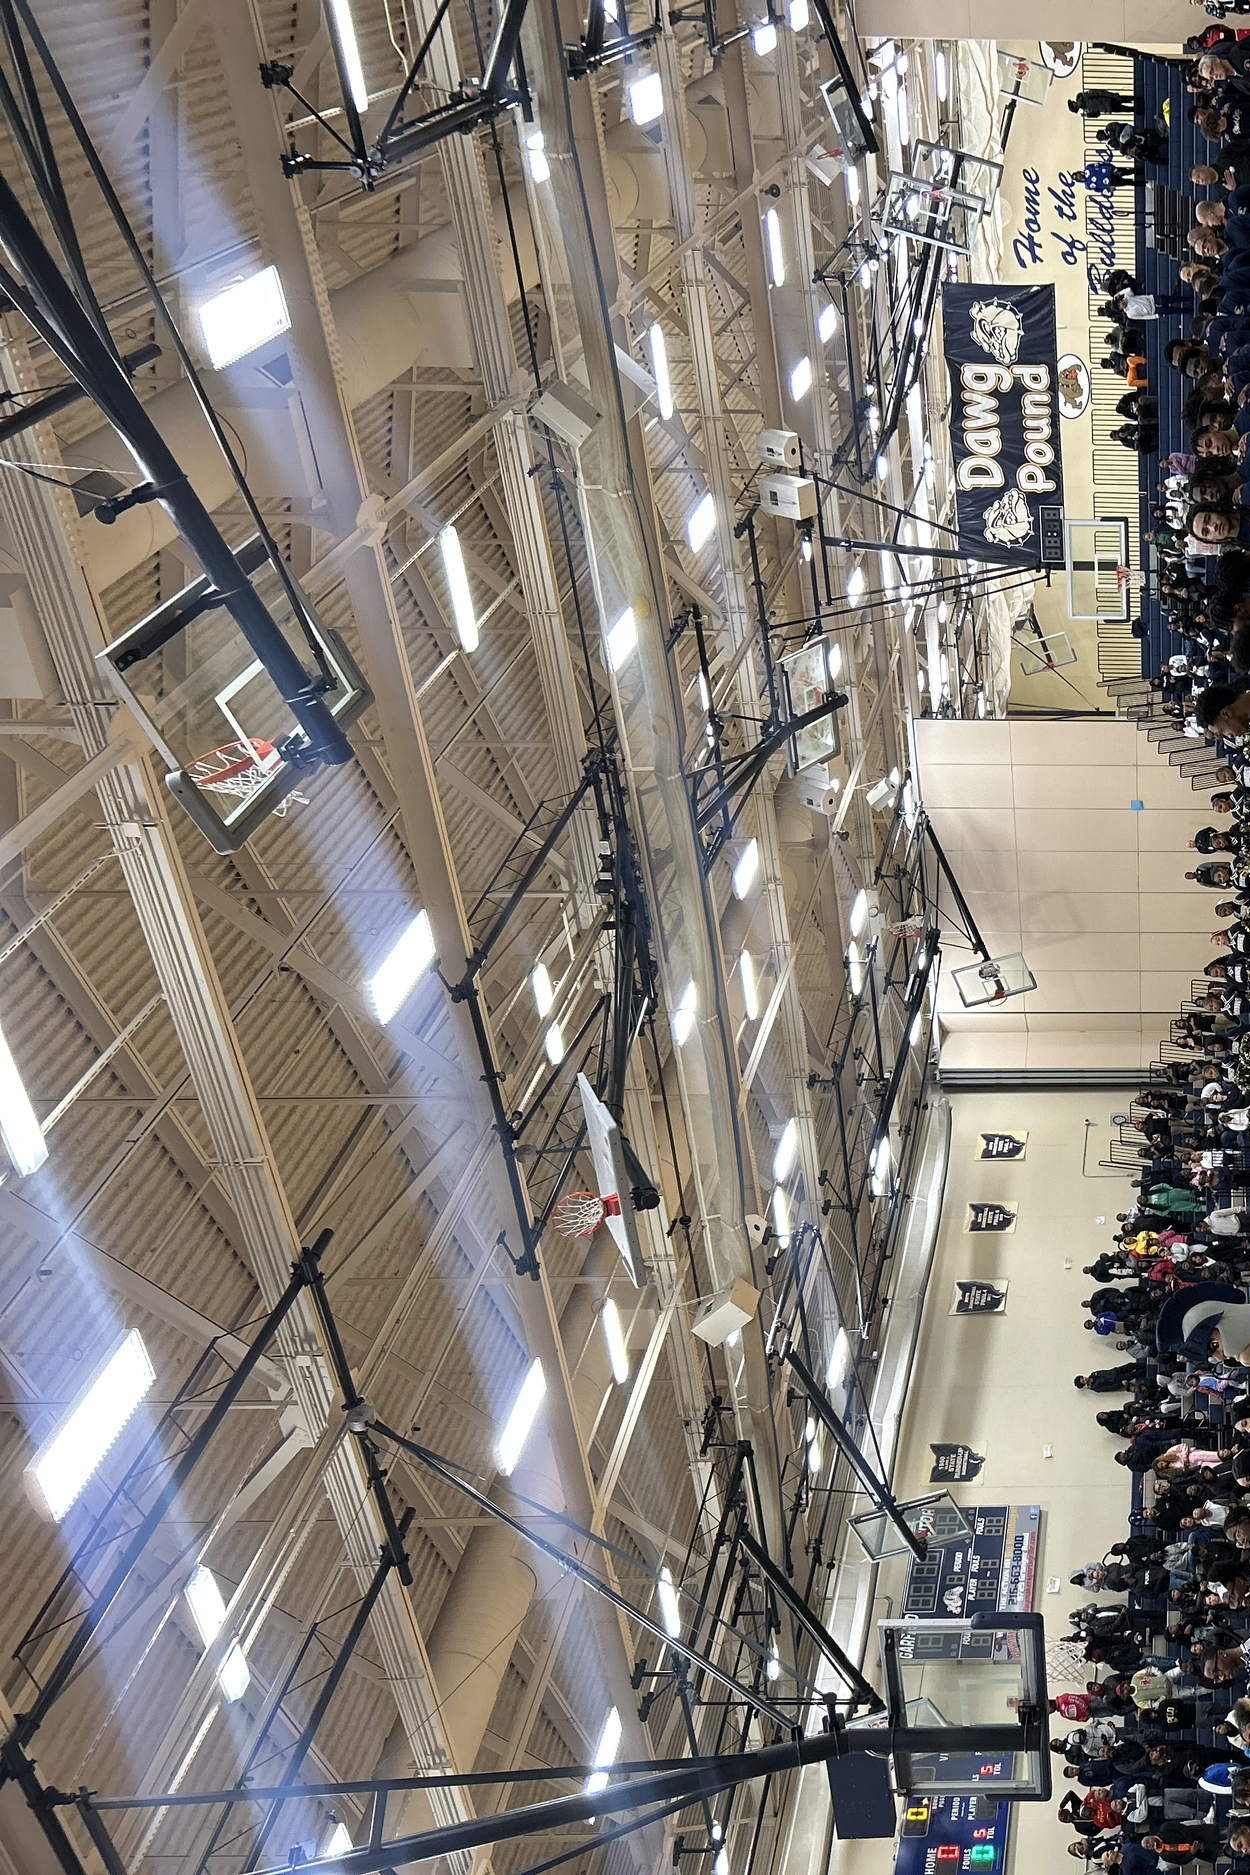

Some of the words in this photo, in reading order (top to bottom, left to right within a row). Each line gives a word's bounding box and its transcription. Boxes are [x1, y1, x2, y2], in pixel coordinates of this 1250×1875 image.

[1048, 170, 1077, 222] the
[1013, 167, 1043, 268] Home
[1050, 232, 1086, 265] of
[956, 363, 1014, 491] Dawg
[1010, 364, 1056, 493] Pound
[948, 1454, 956, 1472] STATE
[976, 1517, 985, 1535] FOULS
[953, 1551, 963, 1572] PERIOD
[971, 1555, 980, 1572] FOULS
[1008, 1535, 1024, 1605] 216-663-8000
[968, 1578, 977, 1600] PLAYER
[951, 1797, 960, 1820] PERIOD
[968, 1797, 977, 1820] PLAYER
[987, 1827, 995, 1839] TOL
[924, 1848, 937, 1874] HOME
[937, 1845, 960, 1859] 0
[962, 1848, 971, 1869] FOULS
